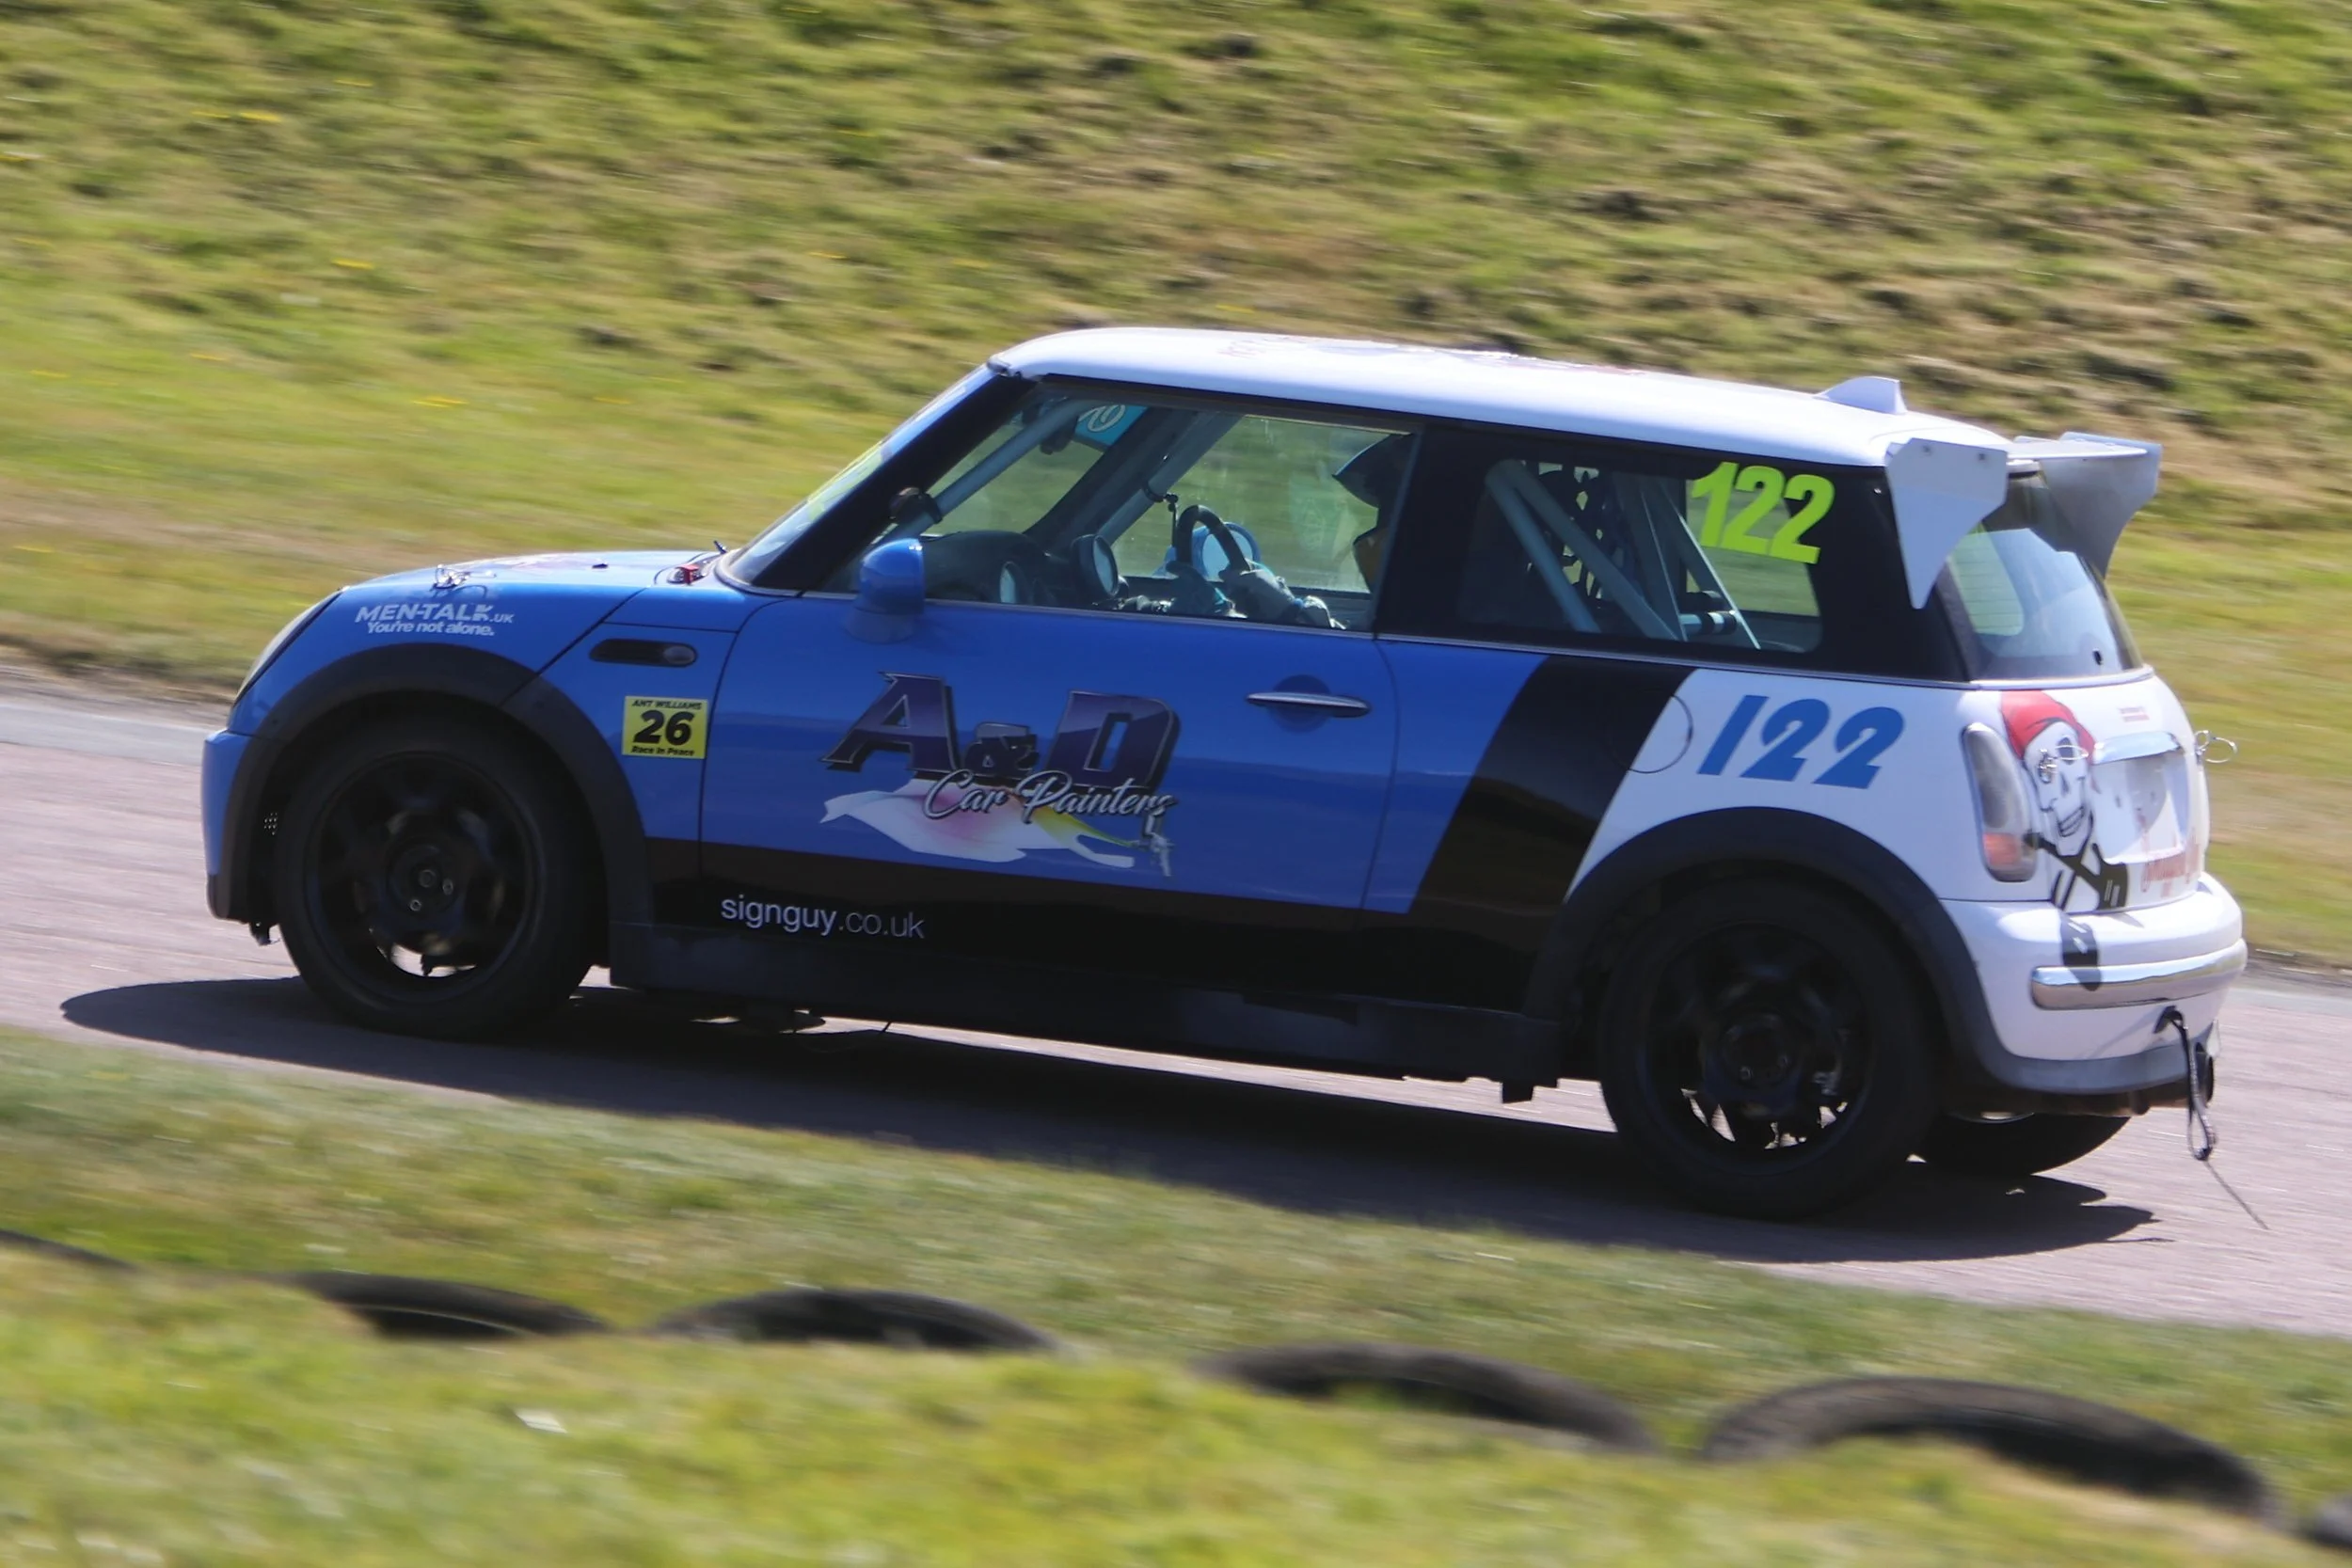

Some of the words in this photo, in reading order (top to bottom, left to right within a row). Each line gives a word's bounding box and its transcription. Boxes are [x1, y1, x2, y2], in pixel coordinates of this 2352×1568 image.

[1691, 461, 1836, 564] 122
[368, 620, 414, 634] You're
[416, 622, 444, 633] not
[445, 622, 495, 636] alone.
[633, 709, 695, 746] 26
[1696, 694, 1907, 790] 122
[630, 745, 655, 754] Race
[667, 748, 694, 756] Peace
[922, 769, 1012, 819] Car
[1013, 770, 1179, 825] Painters
[721, 894, 925, 939] signguy.co.uk
